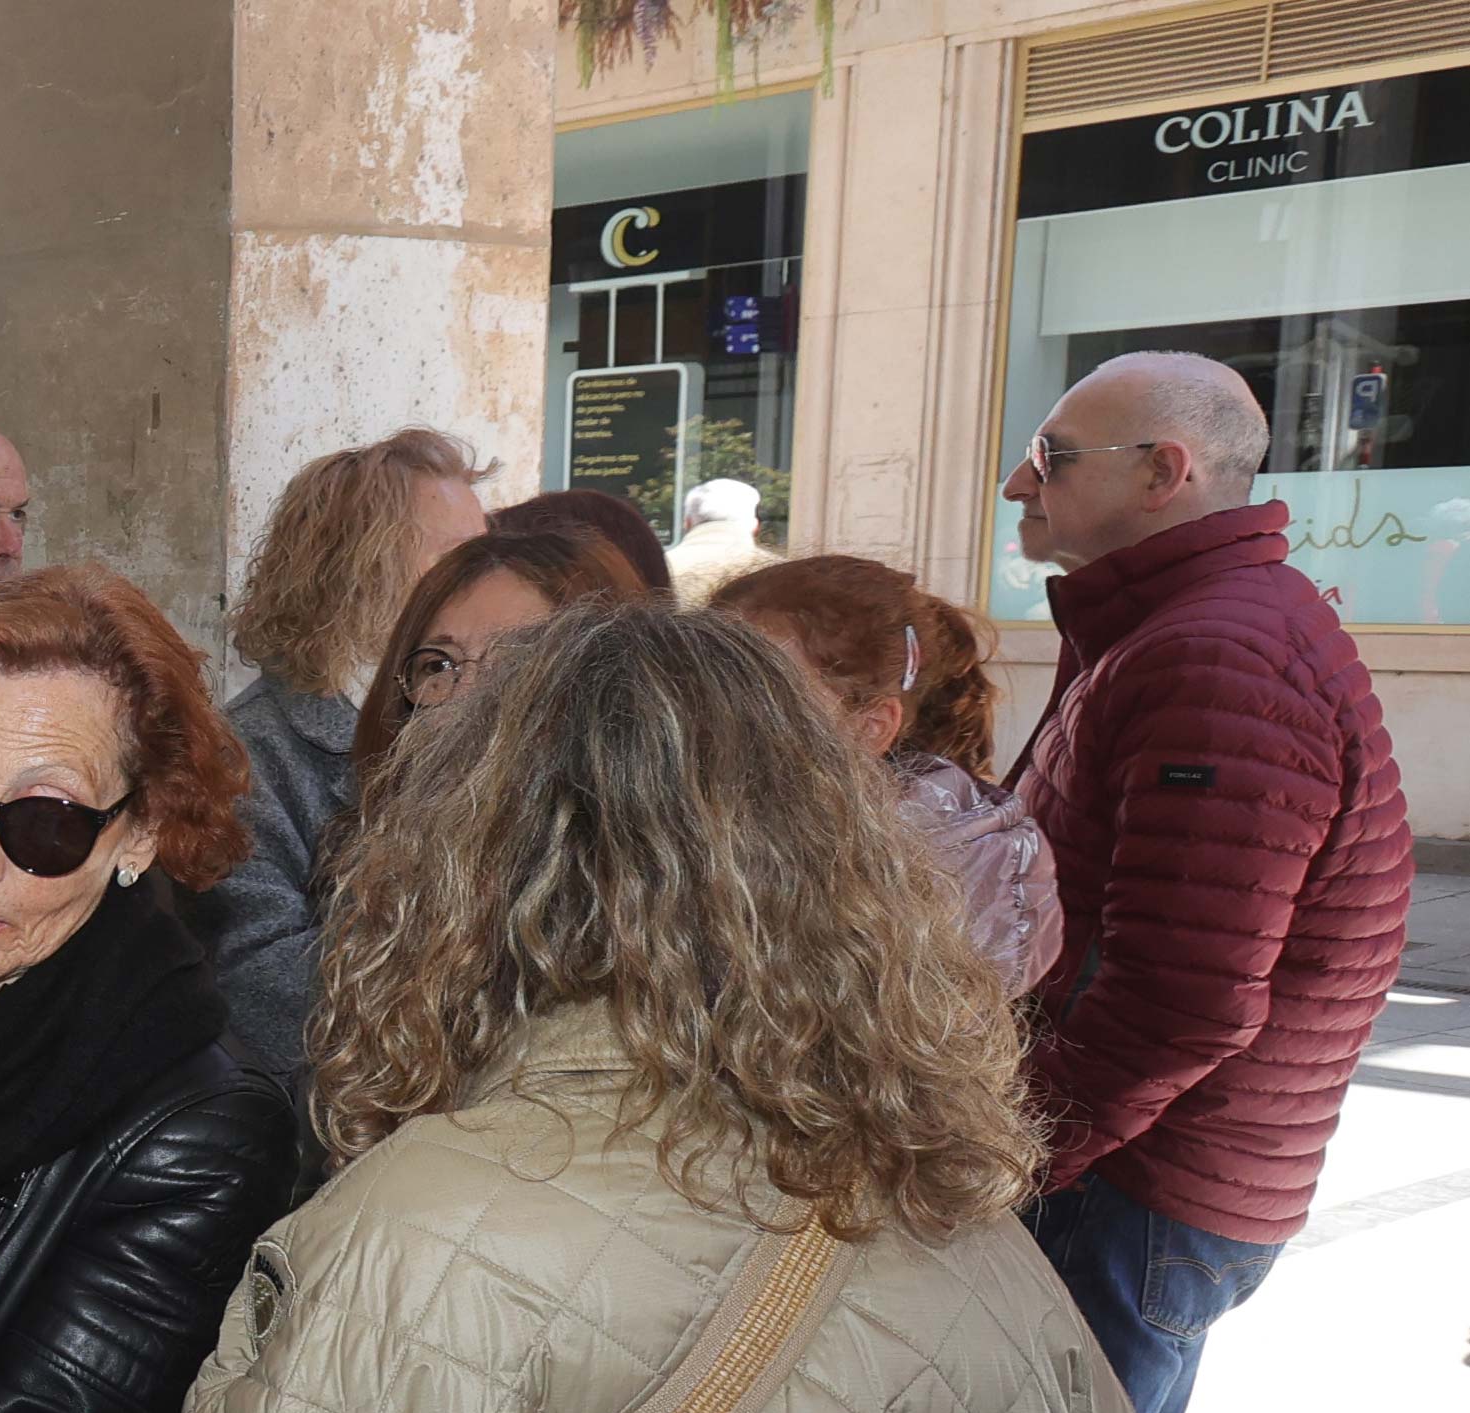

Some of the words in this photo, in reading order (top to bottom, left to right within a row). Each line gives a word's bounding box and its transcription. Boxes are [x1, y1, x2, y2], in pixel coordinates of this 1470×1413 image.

[1155, 91, 1374, 154] COLINA
[1207, 150, 1310, 183] CLINIC
[1272, 477, 1428, 554] ids
